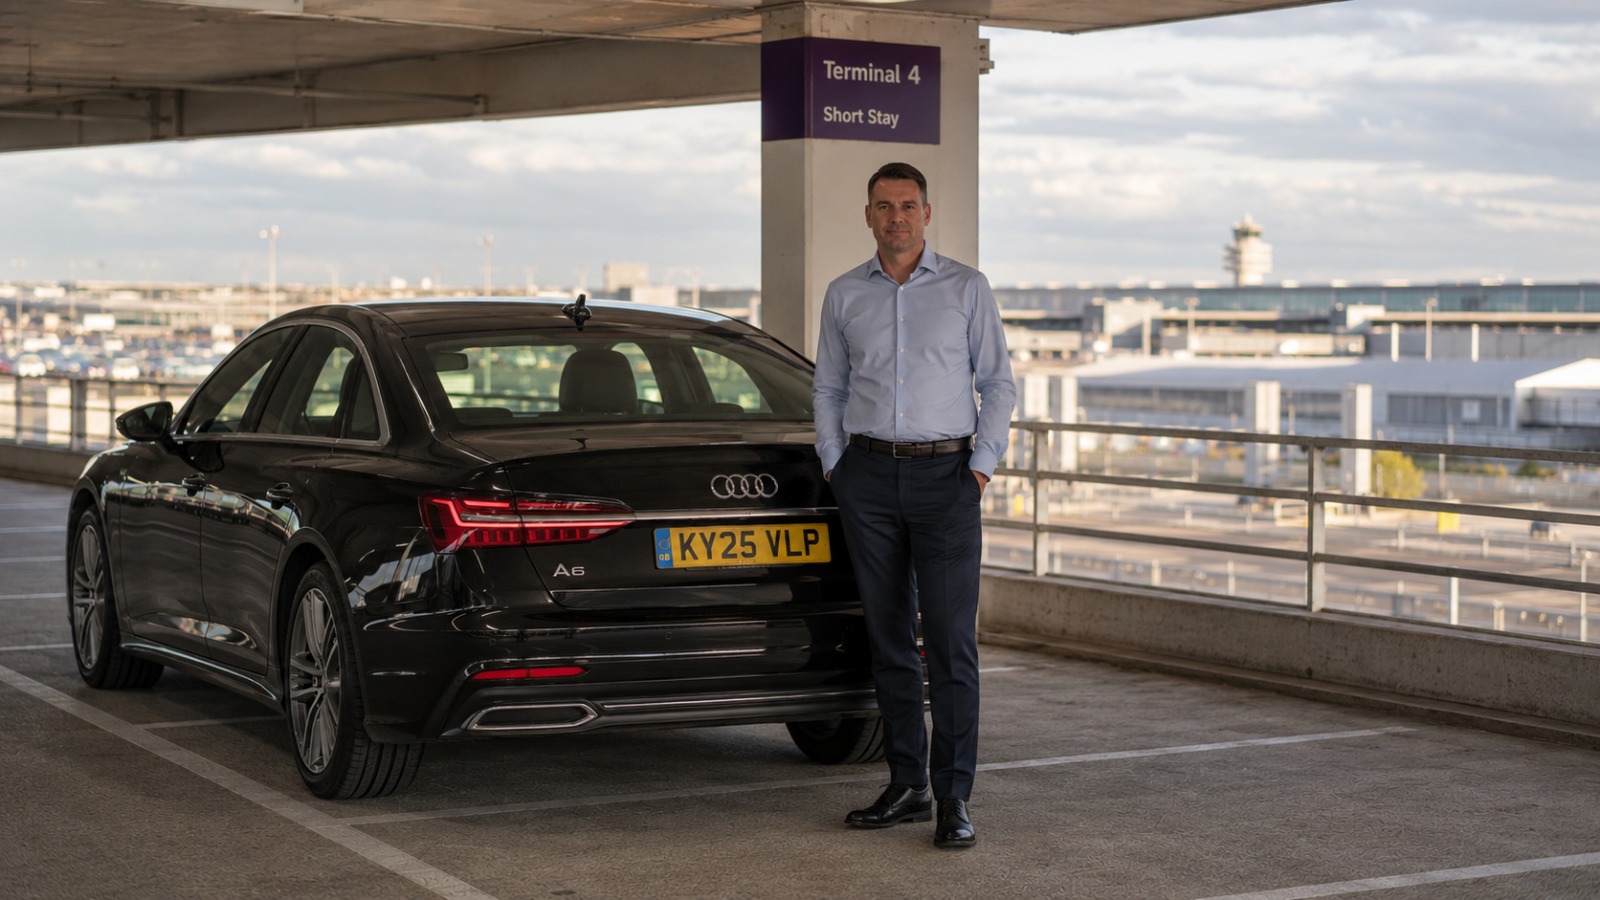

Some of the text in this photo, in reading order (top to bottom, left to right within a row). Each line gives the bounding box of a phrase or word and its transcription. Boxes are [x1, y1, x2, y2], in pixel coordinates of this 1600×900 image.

[823, 60, 921, 85] Terminal 4
[823, 106, 899, 129] Short Stay
[679, 529, 820, 561] KY25 VLP
[553, 563, 585, 577] A6
